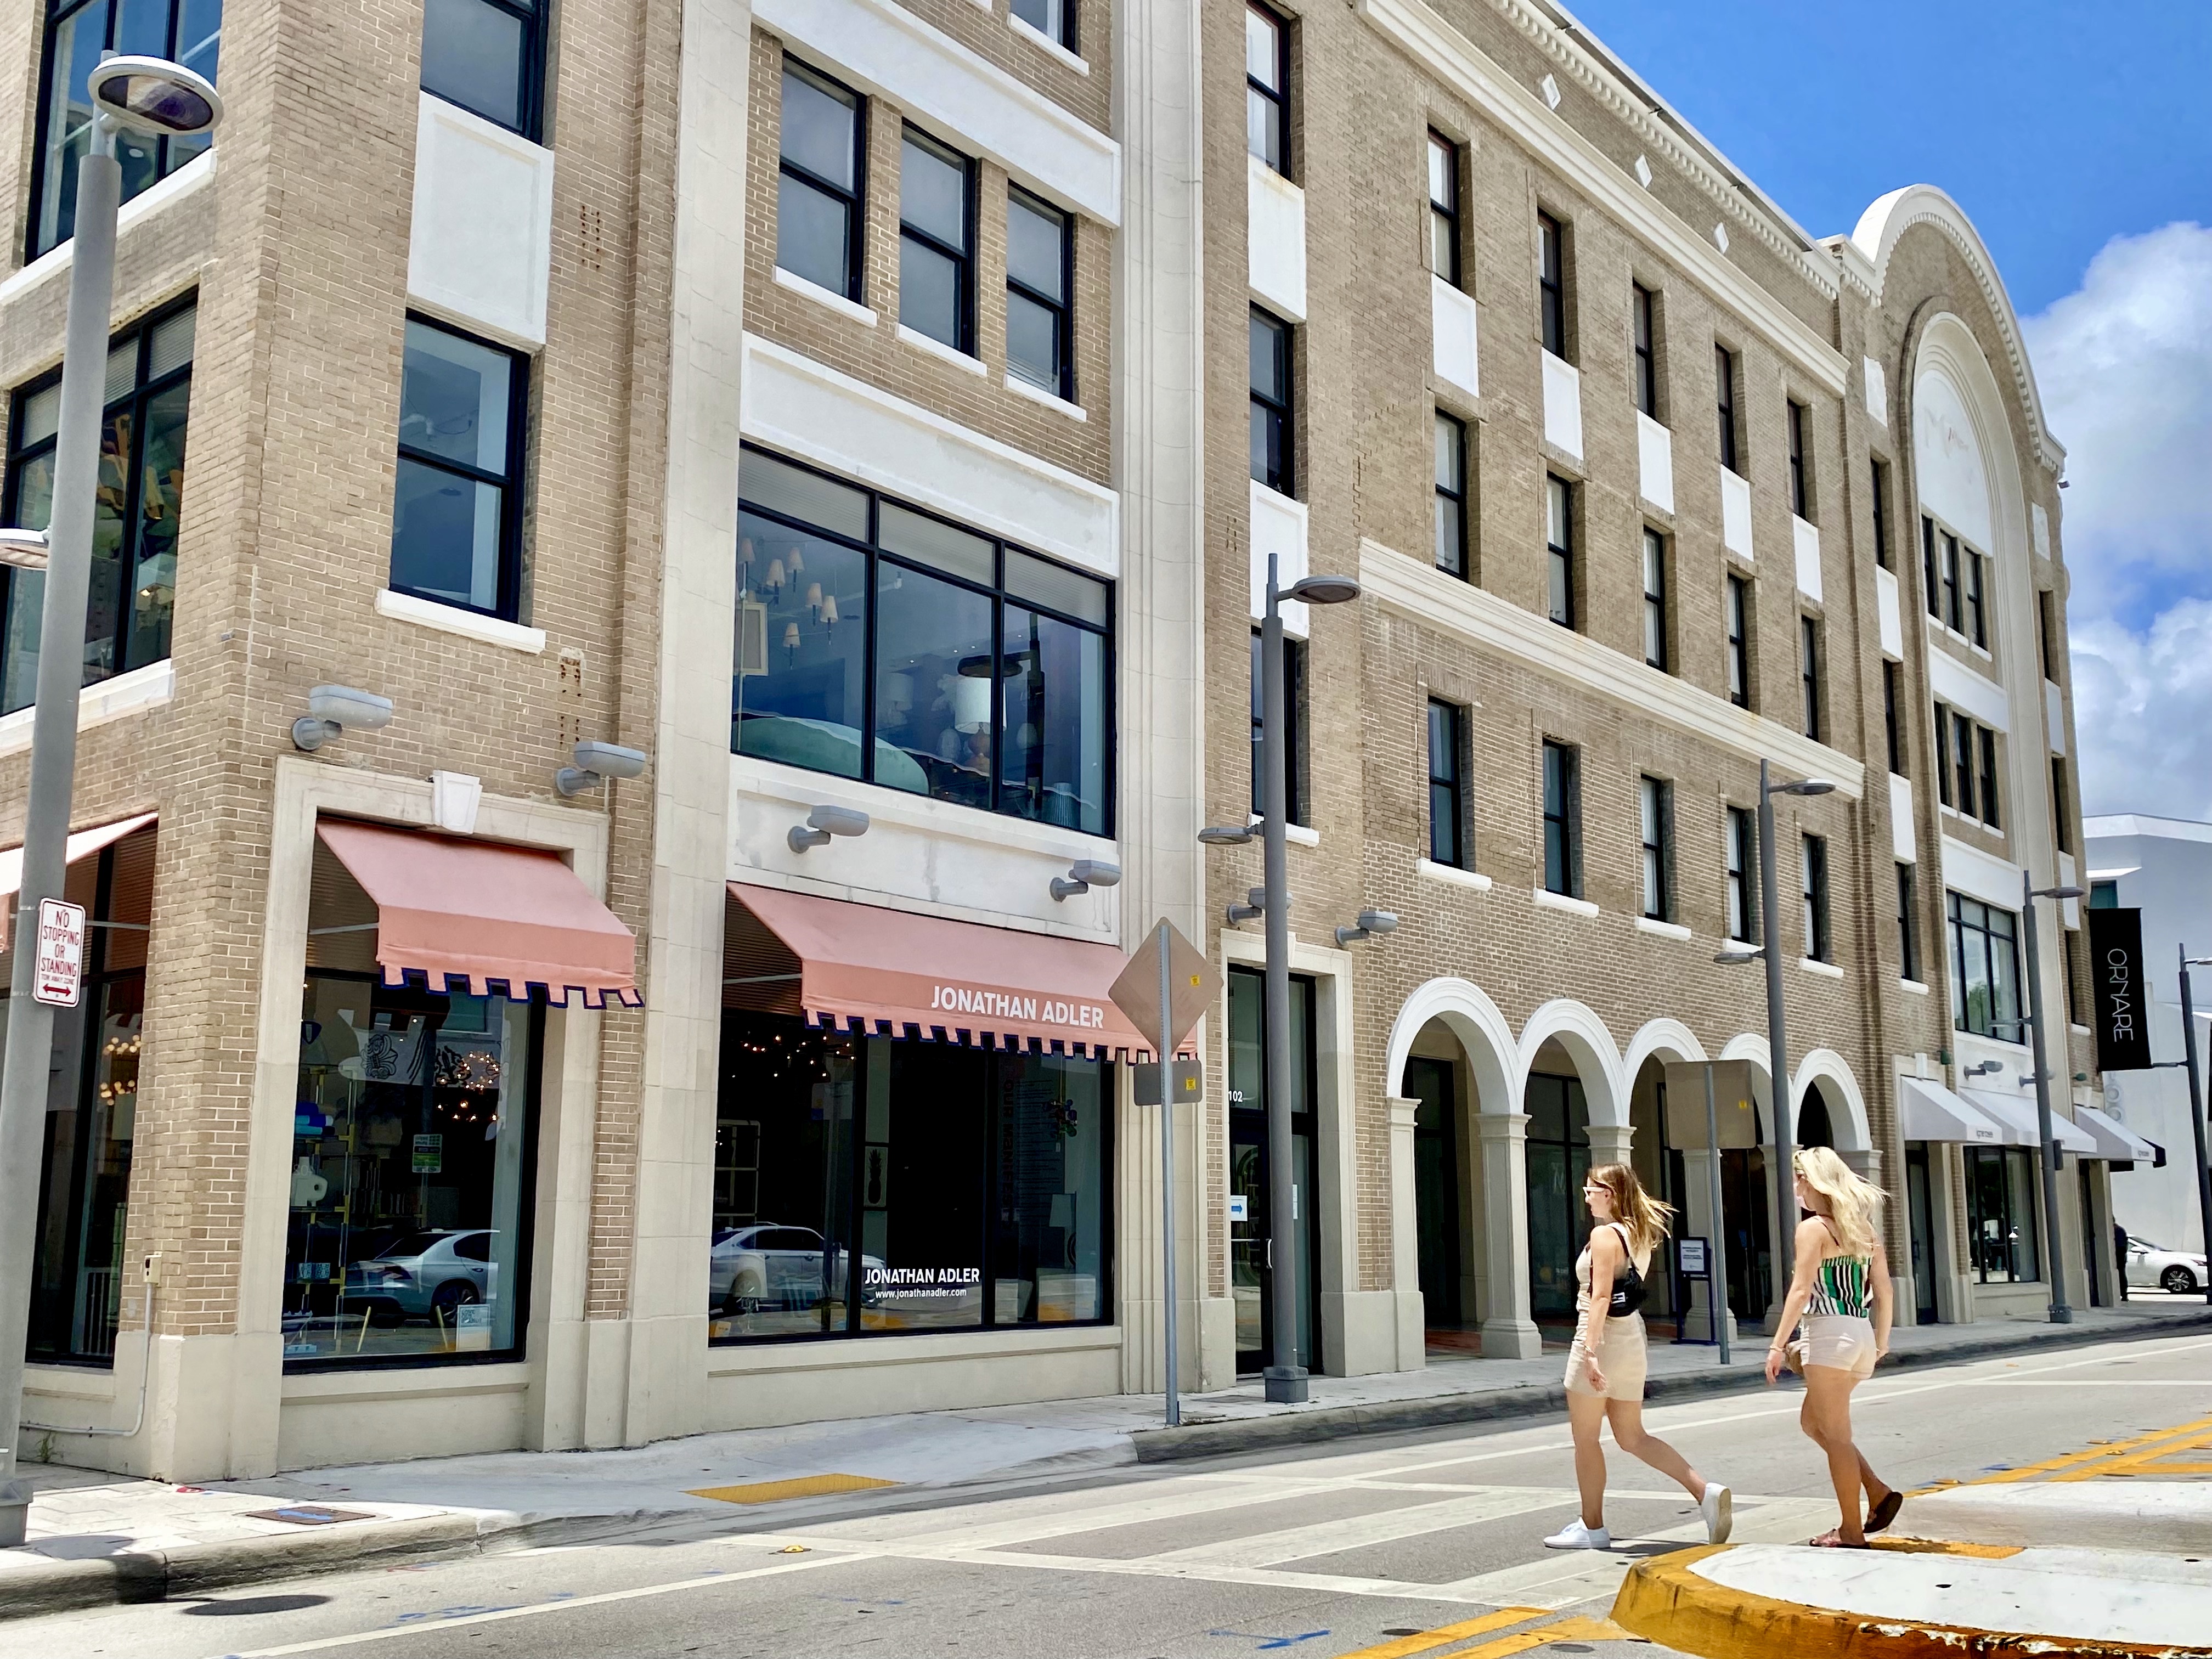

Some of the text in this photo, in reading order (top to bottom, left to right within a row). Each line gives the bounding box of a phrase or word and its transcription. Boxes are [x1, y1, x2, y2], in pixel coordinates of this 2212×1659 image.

[55, 911, 69, 928] NO
[43, 925, 80, 946] STOPPING
[55, 944, 65, 959] OR
[41, 957, 77, 977] STANDING
[2107, 949, 2134, 1042] ORNARE
[931, 985, 1104, 1029] JONATHAN ADLER
[1228, 1090, 1243, 1102] 102
[865, 1268, 980, 1284] JONATHAN ADLER
[875, 1287, 967, 1300] www.jonathanadler.com
